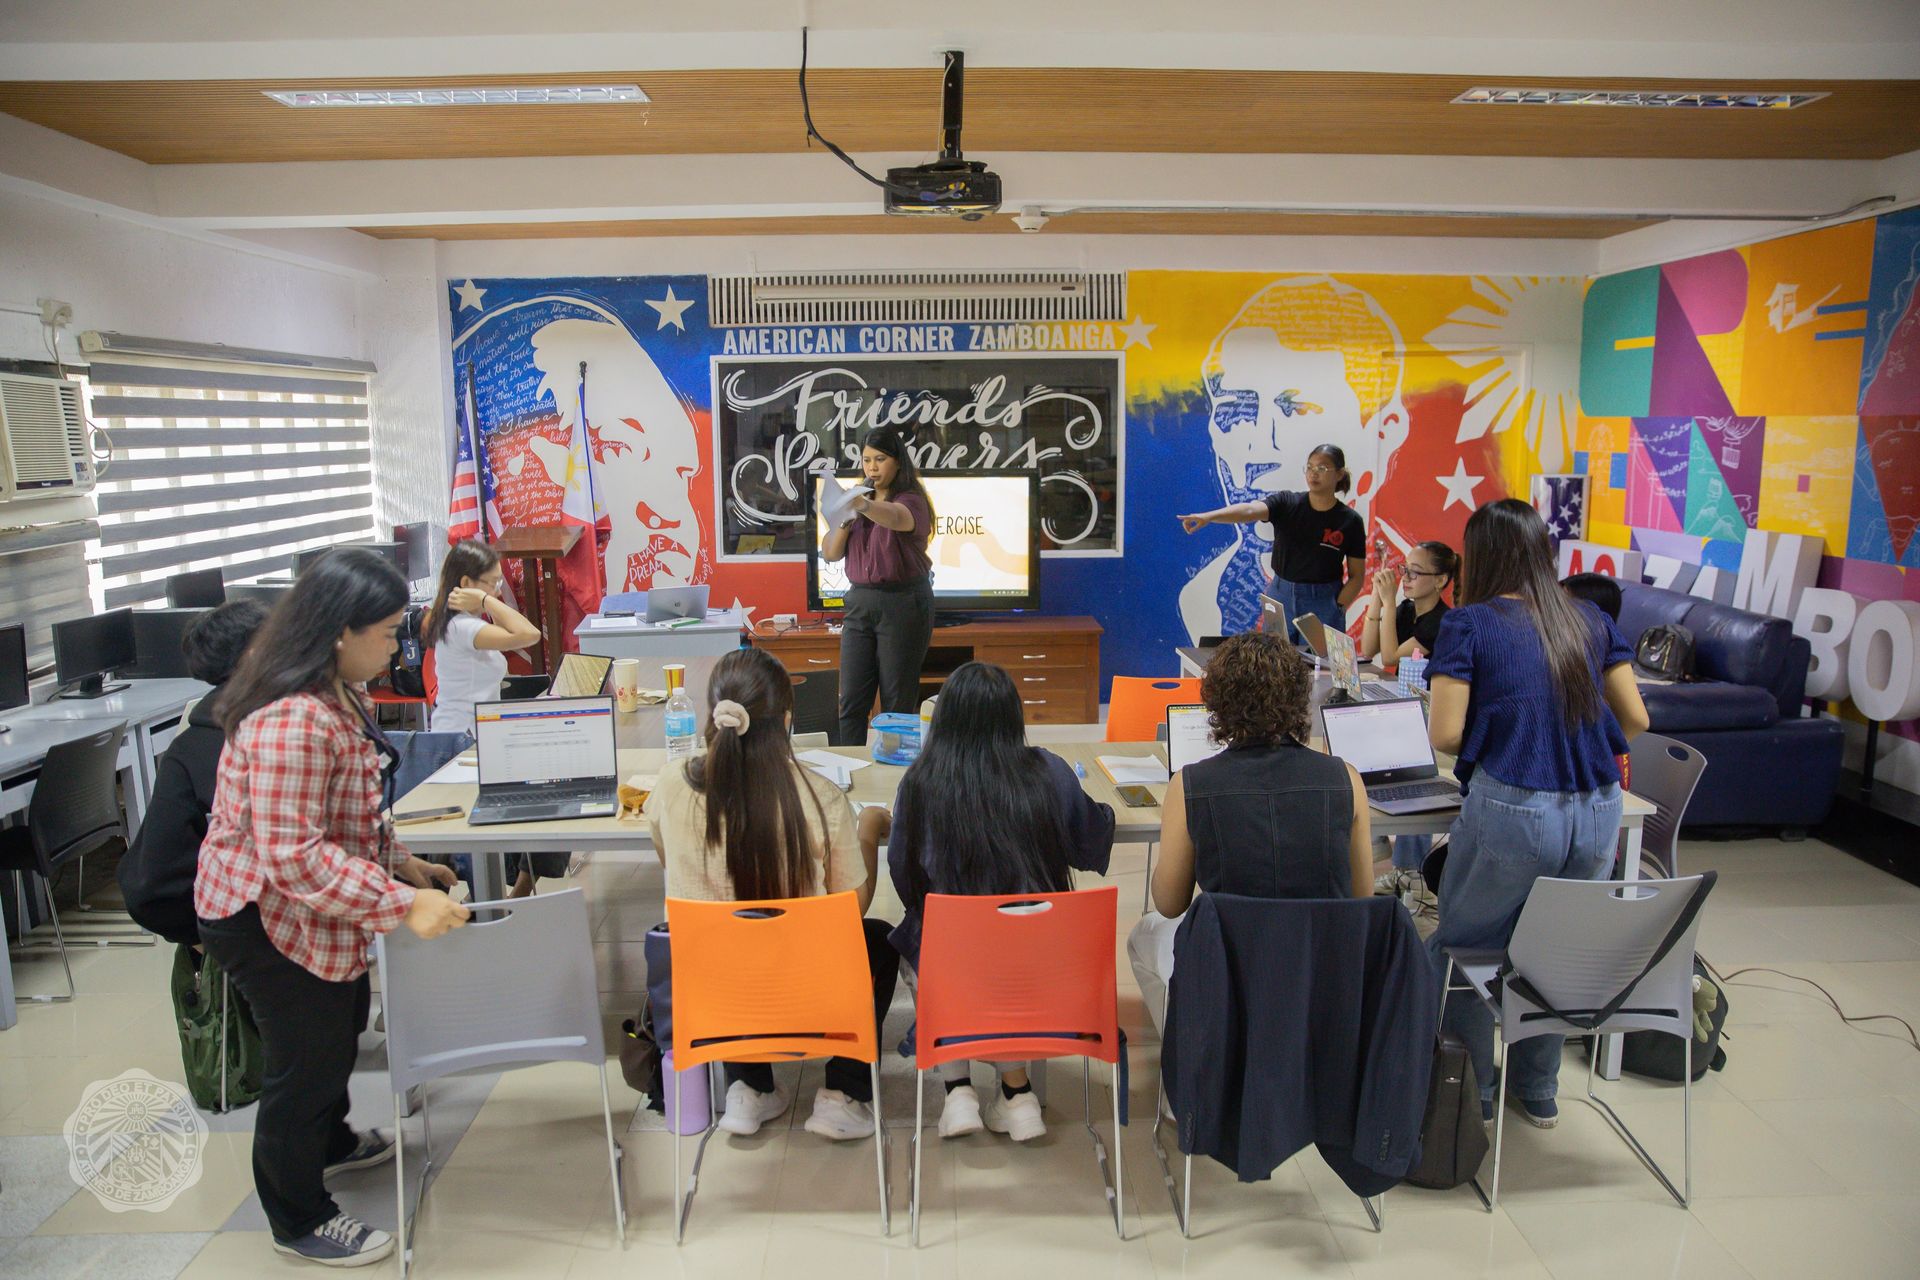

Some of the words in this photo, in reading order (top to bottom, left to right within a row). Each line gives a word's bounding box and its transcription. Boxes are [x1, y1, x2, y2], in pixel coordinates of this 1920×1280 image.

[722, 327, 846, 355] AMERICAN
[858, 325, 955, 352] CORNER
[968, 323, 1117, 351] ZAMBOANGA
[727, 367, 1026, 433] Friends
[775, 432, 1058, 501] Parners
[936, 515, 985, 535] ERCISE
[638, 536, 665, 562] HAVE
[670, 540, 679, 551] A
[629, 559, 664, 582] DREAM
[406, 646, 416, 660] J
